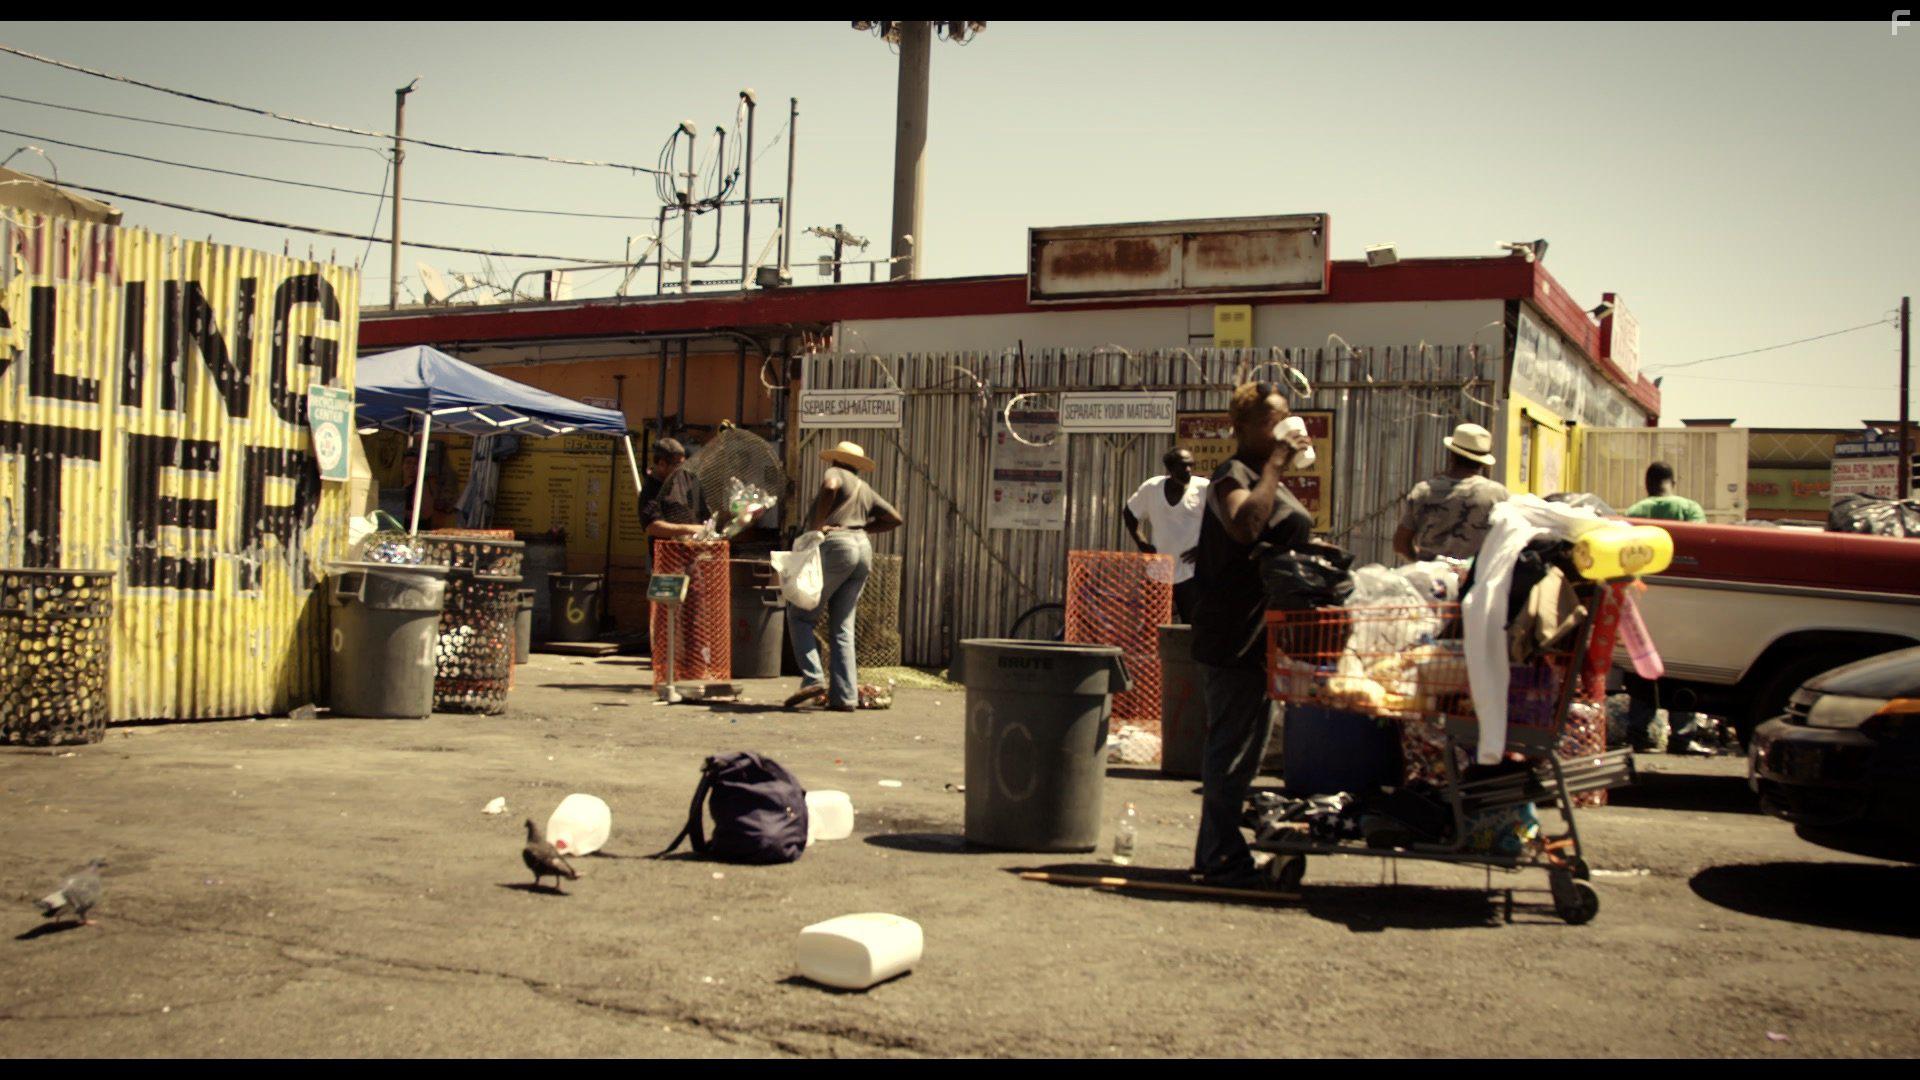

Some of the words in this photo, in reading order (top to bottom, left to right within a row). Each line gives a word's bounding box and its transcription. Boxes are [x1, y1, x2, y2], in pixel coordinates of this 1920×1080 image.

[0, 273, 340, 427] LING
[804, 400, 837, 414] SEPARE
[852, 400, 896, 414] MATERIAL
[1065, 404, 1103, 419] SEPARATE
[1104, 404, 1125, 419] YOUR
[1127, 404, 1171, 419] MATERIALS
[314, 408, 344, 423] CENTER
[566, 596, 585, 623] 6
[998, 656, 1054, 669] BRUTE
